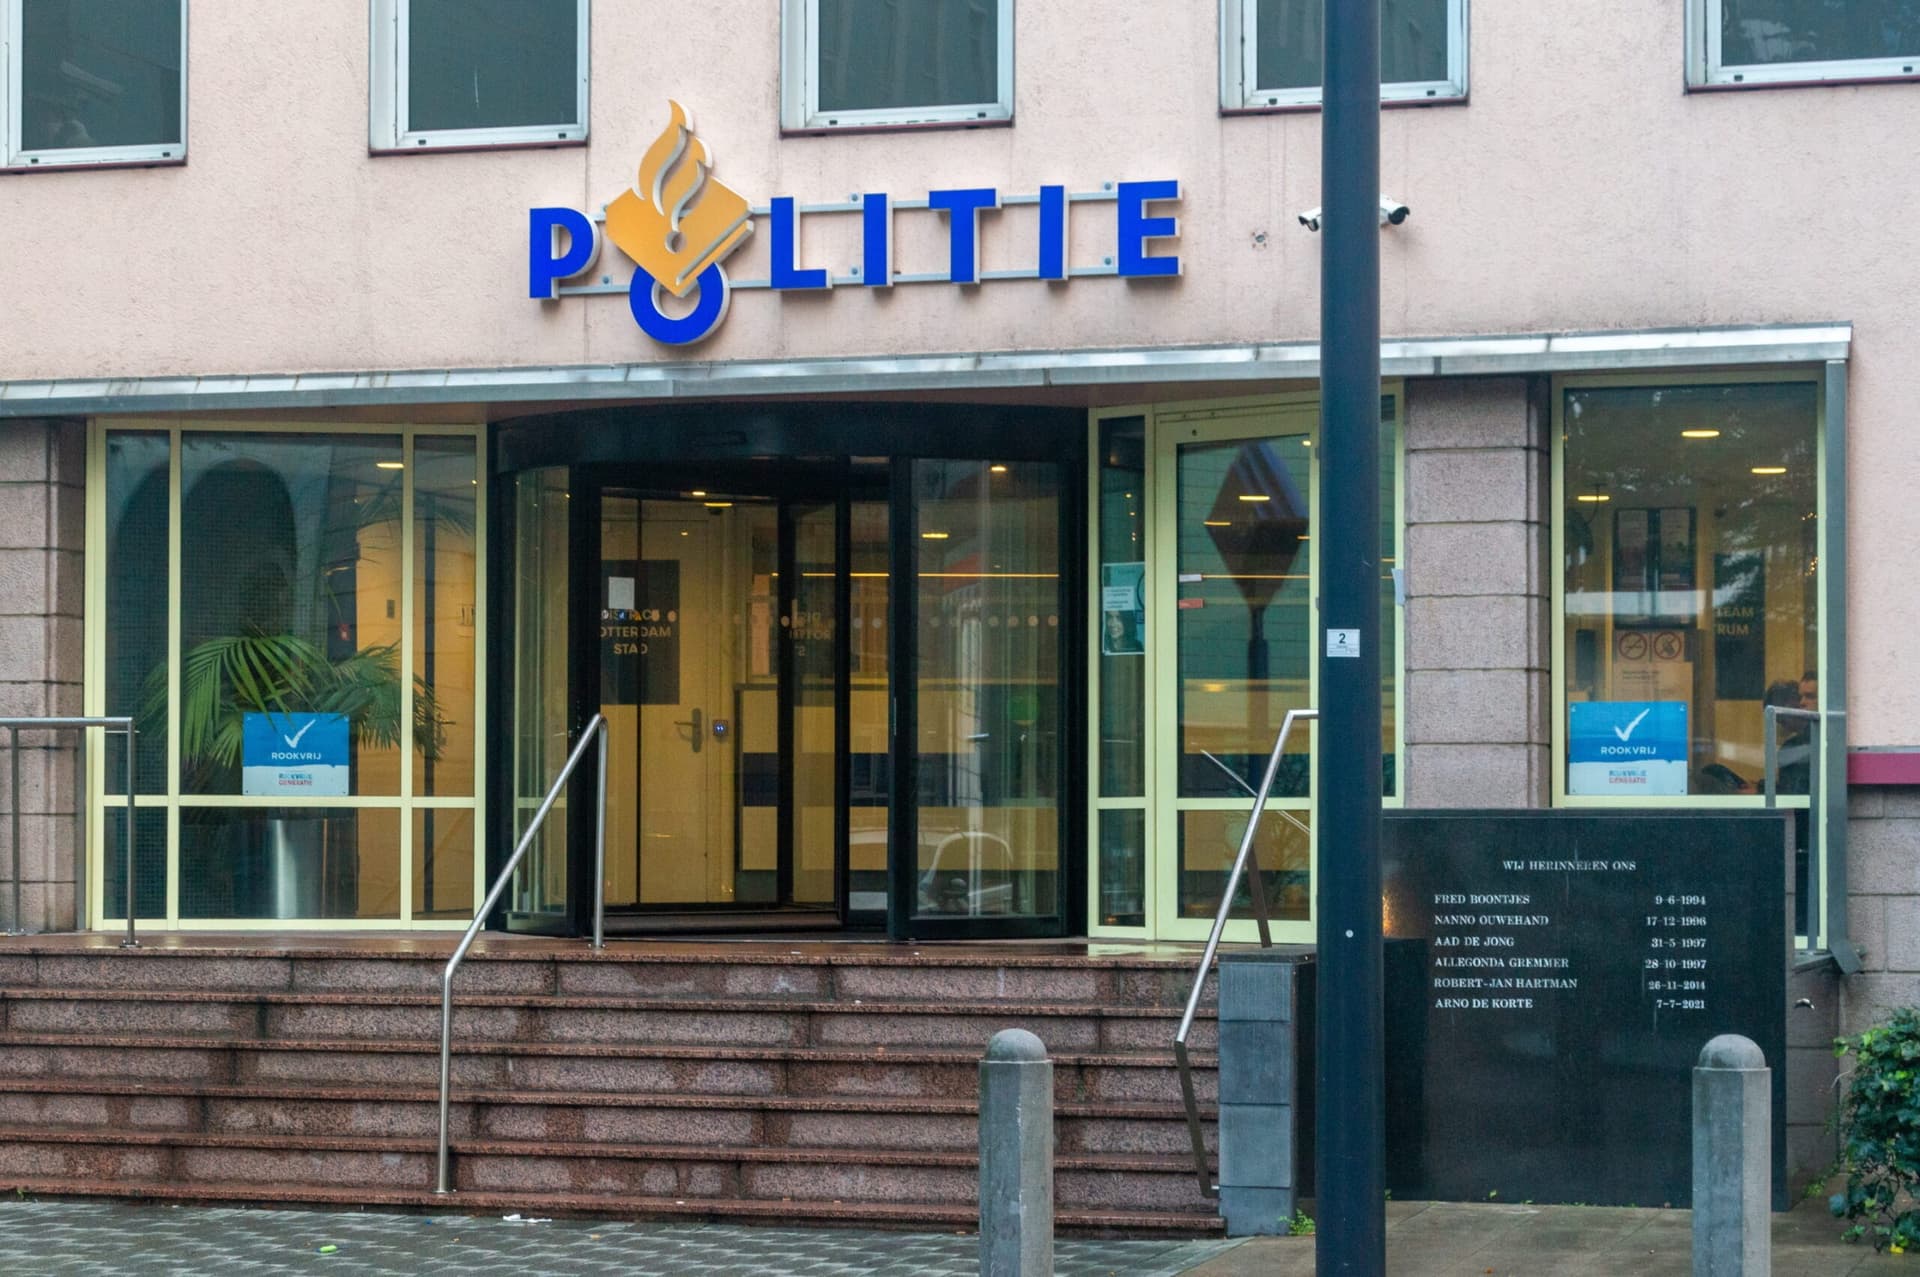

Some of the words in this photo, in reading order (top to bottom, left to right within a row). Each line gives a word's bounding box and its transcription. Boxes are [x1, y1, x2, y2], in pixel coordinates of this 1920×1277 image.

[529, 179, 1183, 345] POLITIE
[600, 626, 672, 638] OTTERDAM
[1716, 623, 1750, 635] RUM
[1338, 632, 1347, 645] 2
[613, 643, 649, 655] STAD
[271, 751, 322, 760] ROOKVRIJ
[1600, 746, 1657, 756] ROOKVRIJ
[1503, 860, 1525, 872] WIJ
[1529, 860, 1609, 871] HERINNEREN
[1612, 860, 1637, 871] ONS
[1434, 894, 1466, 905] FRED
[1470, 894, 1530, 905] BOONTJES
[1434, 915, 1476, 926] NANNO
[1479, 915, 1550, 926] OUWEHAND
[1434, 936, 1460, 947] AAD
[1464, 936, 1480, 947] DE
[1483, 936, 1515, 947] JONG
[1651, 937, 1707, 948] 31-5-1997
[1435, 957, 1505, 968] ALLEGONDA
[1508, 957, 1569, 968] GREMMER
[1645, 958, 1707, 969] 28-10-1997
[1434, 977, 1513, 988] ROBERT-JAN
[1516, 978, 1578, 989] HARTMAN
[1435, 998, 1470, 1009] ARNO
[1472, 998, 1489, 1009] DE
[1491, 998, 1534, 1009] KORTE
[1656, 999, 1705, 1009] 7-7-2021
